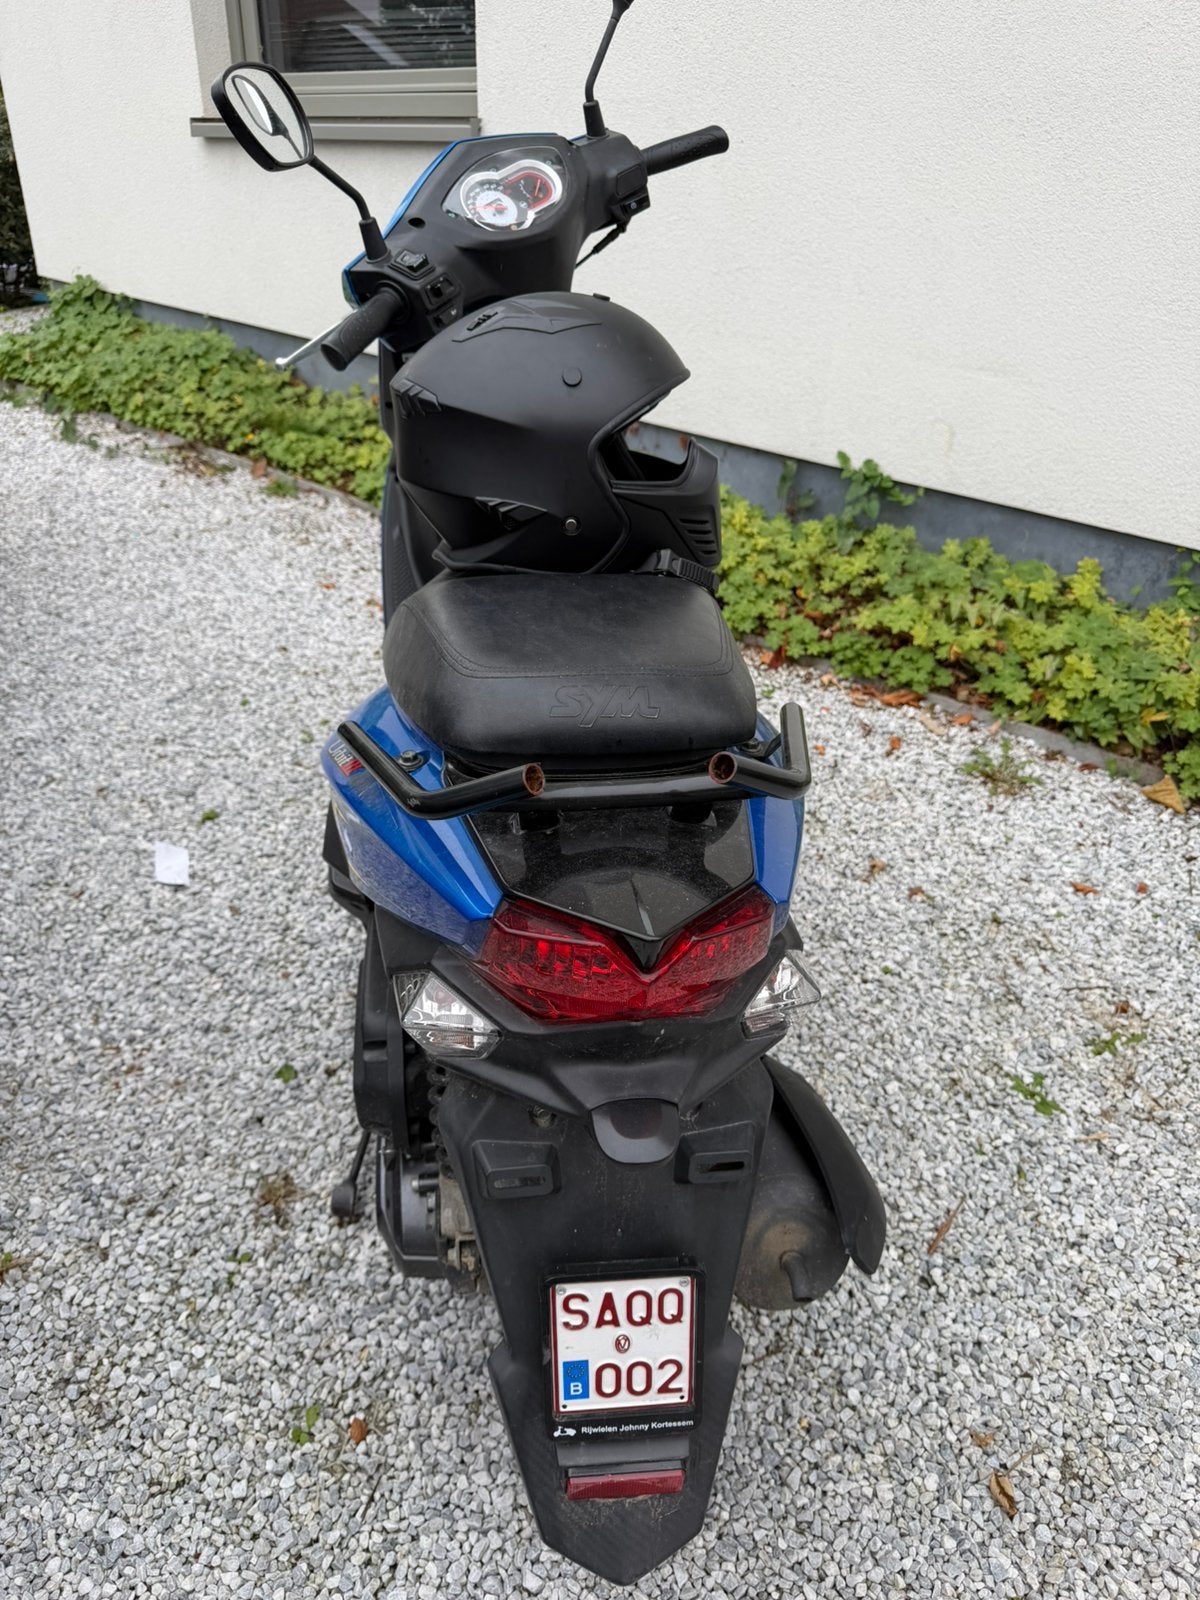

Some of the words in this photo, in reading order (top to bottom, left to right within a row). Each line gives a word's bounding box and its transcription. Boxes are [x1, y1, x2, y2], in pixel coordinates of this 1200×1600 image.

[549, 684, 660, 728] SYM
[562, 1288, 684, 1331] SAQQ
[570, 1382, 583, 1396] B
[595, 1358, 684, 1398] 002
[581, 1425, 618, 1435] Rijwielen
[619, 1422, 650, 1432] Johnny
[651, 1419, 694, 1429] Kortessem
